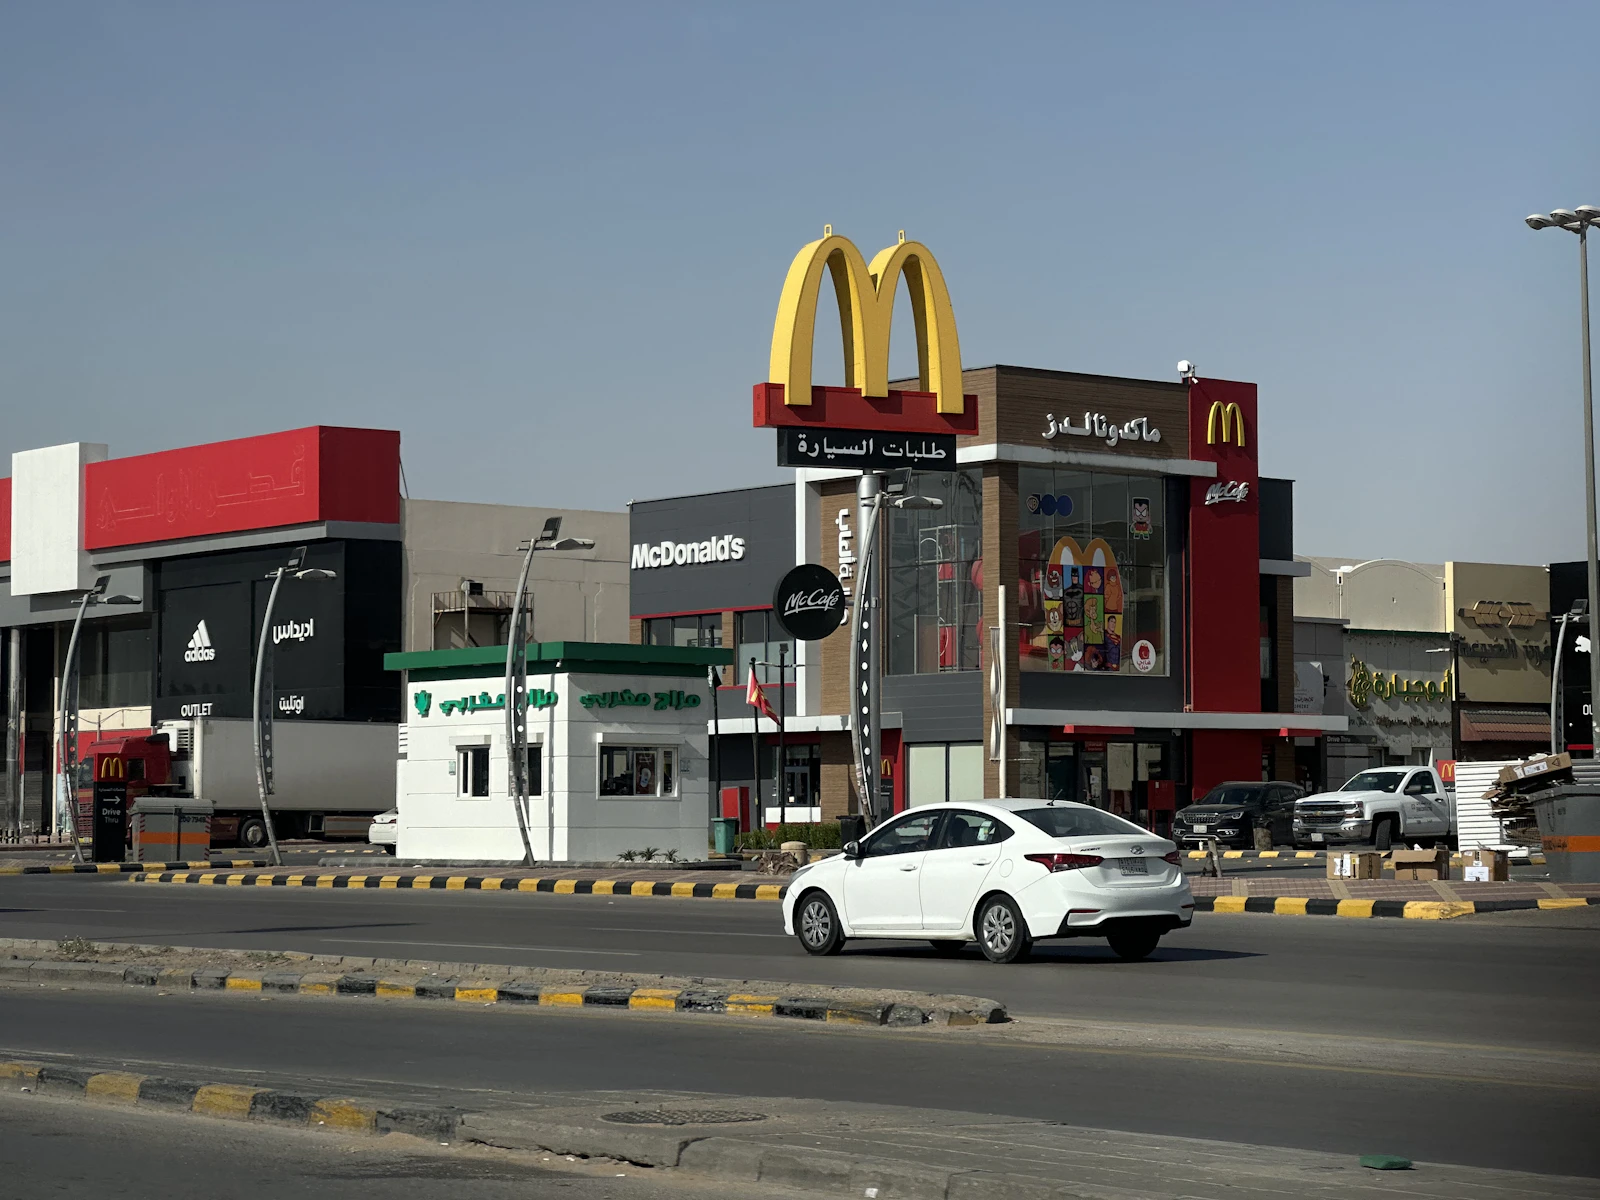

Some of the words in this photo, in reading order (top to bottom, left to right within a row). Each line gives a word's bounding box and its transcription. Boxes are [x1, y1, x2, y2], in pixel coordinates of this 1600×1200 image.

[1041, 410, 1162, 447] ماكدونالدز
[797, 433, 874, 459] السيارة
[882, 440, 947, 463] طلبات
[631, 534, 746, 570] McDonald's
[784, 588, 840, 616] McCafé
[272, 618, 315, 645] اديداس
[184, 646, 216, 663] adidas
[180, 703, 213, 717] OUTLET
[579, 688, 652, 709] مغربي
[653, 689, 701, 711] مزاج
[102, 807, 121, 816] Drive
